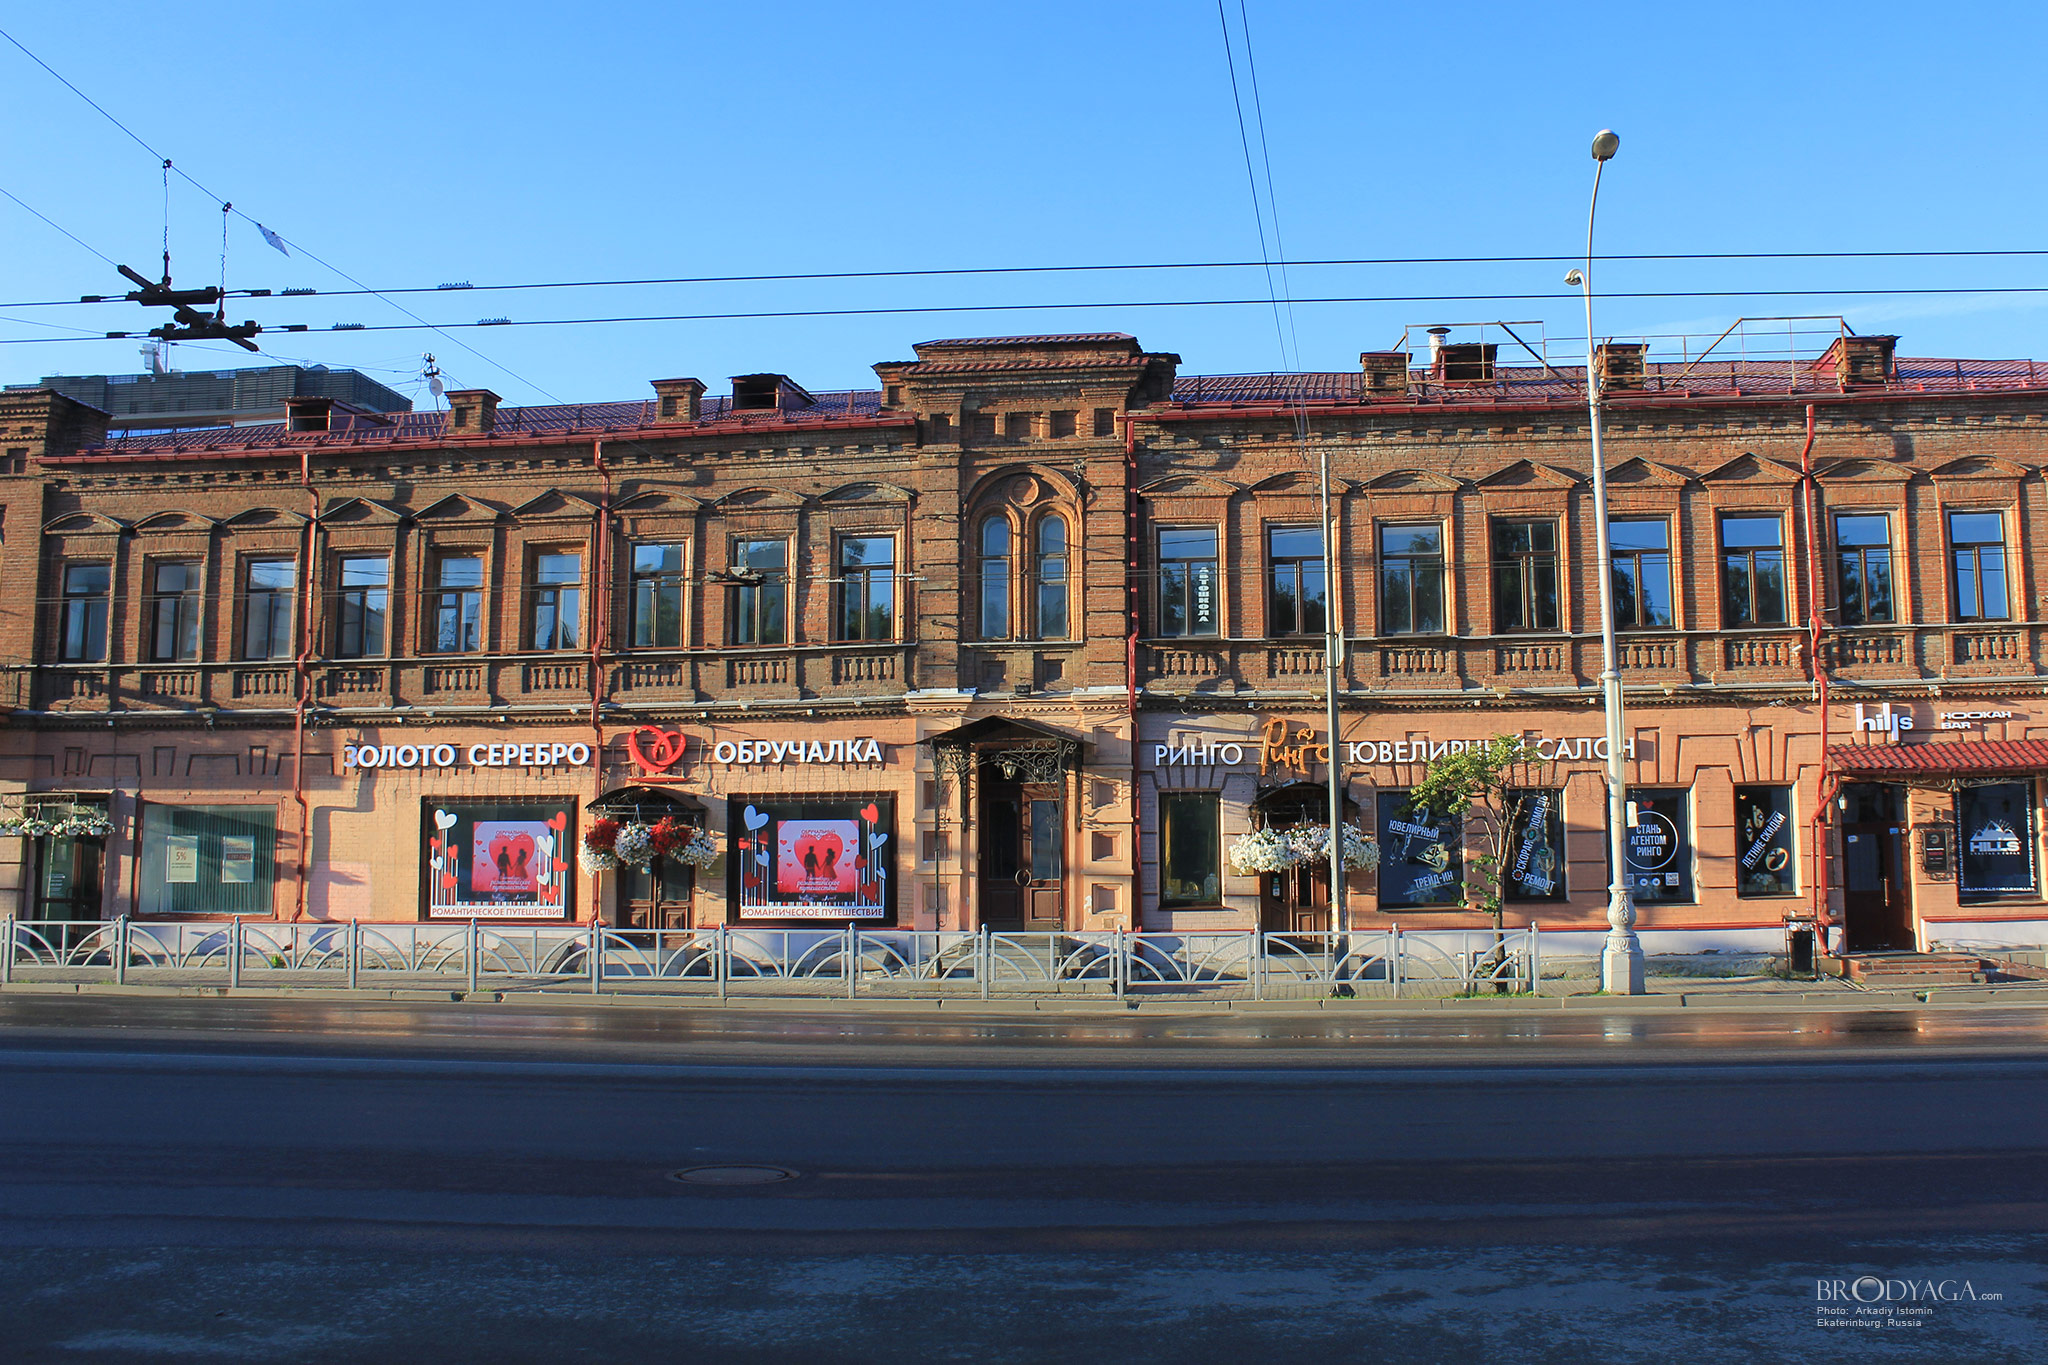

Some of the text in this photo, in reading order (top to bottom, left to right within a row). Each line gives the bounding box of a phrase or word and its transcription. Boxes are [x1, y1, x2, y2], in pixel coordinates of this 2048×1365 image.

[1855, 702, 1913, 741] hills
[1940, 711, 2012, 720] HOOKAH
[1940, 721, 1971, 730] BAR
[344, 743, 590, 767] ЗОЛОТО СЕРЕБРО
[714, 740, 882, 764] ОБРУЧАЛКА
[1155, 743, 1243, 766] РИНГО
[1389, 820, 1440, 839] ЮВЕЛИРНЫЙ
[1636, 824, 1662, 834] СТАНЬ
[1630, 835, 1667, 845] АГЕНТОМ
[1741, 838, 1767, 869] ЛЕТНИЕ
[1760, 811, 1787, 842] СКИДКИ
[1970, 841, 2020, 852] HILLS
[176, 851, 187, 861] 5%
[1516, 838, 1535, 870] СКОРАЯ
[1636, 846, 1662, 856] РИНГО
[1414, 871, 1454, 888] ТРЕЙД-ИН
[1523, 873, 1556, 892] РЕМОНТ
[432, 907, 564, 916] РОМАНТИЧЕСКОЕ ПУТЕШЕСТВИЕ
[742, 907, 883, 916] РОМАНТИЧЕСКОЕ ПУТЕШЕСТВИЕ
